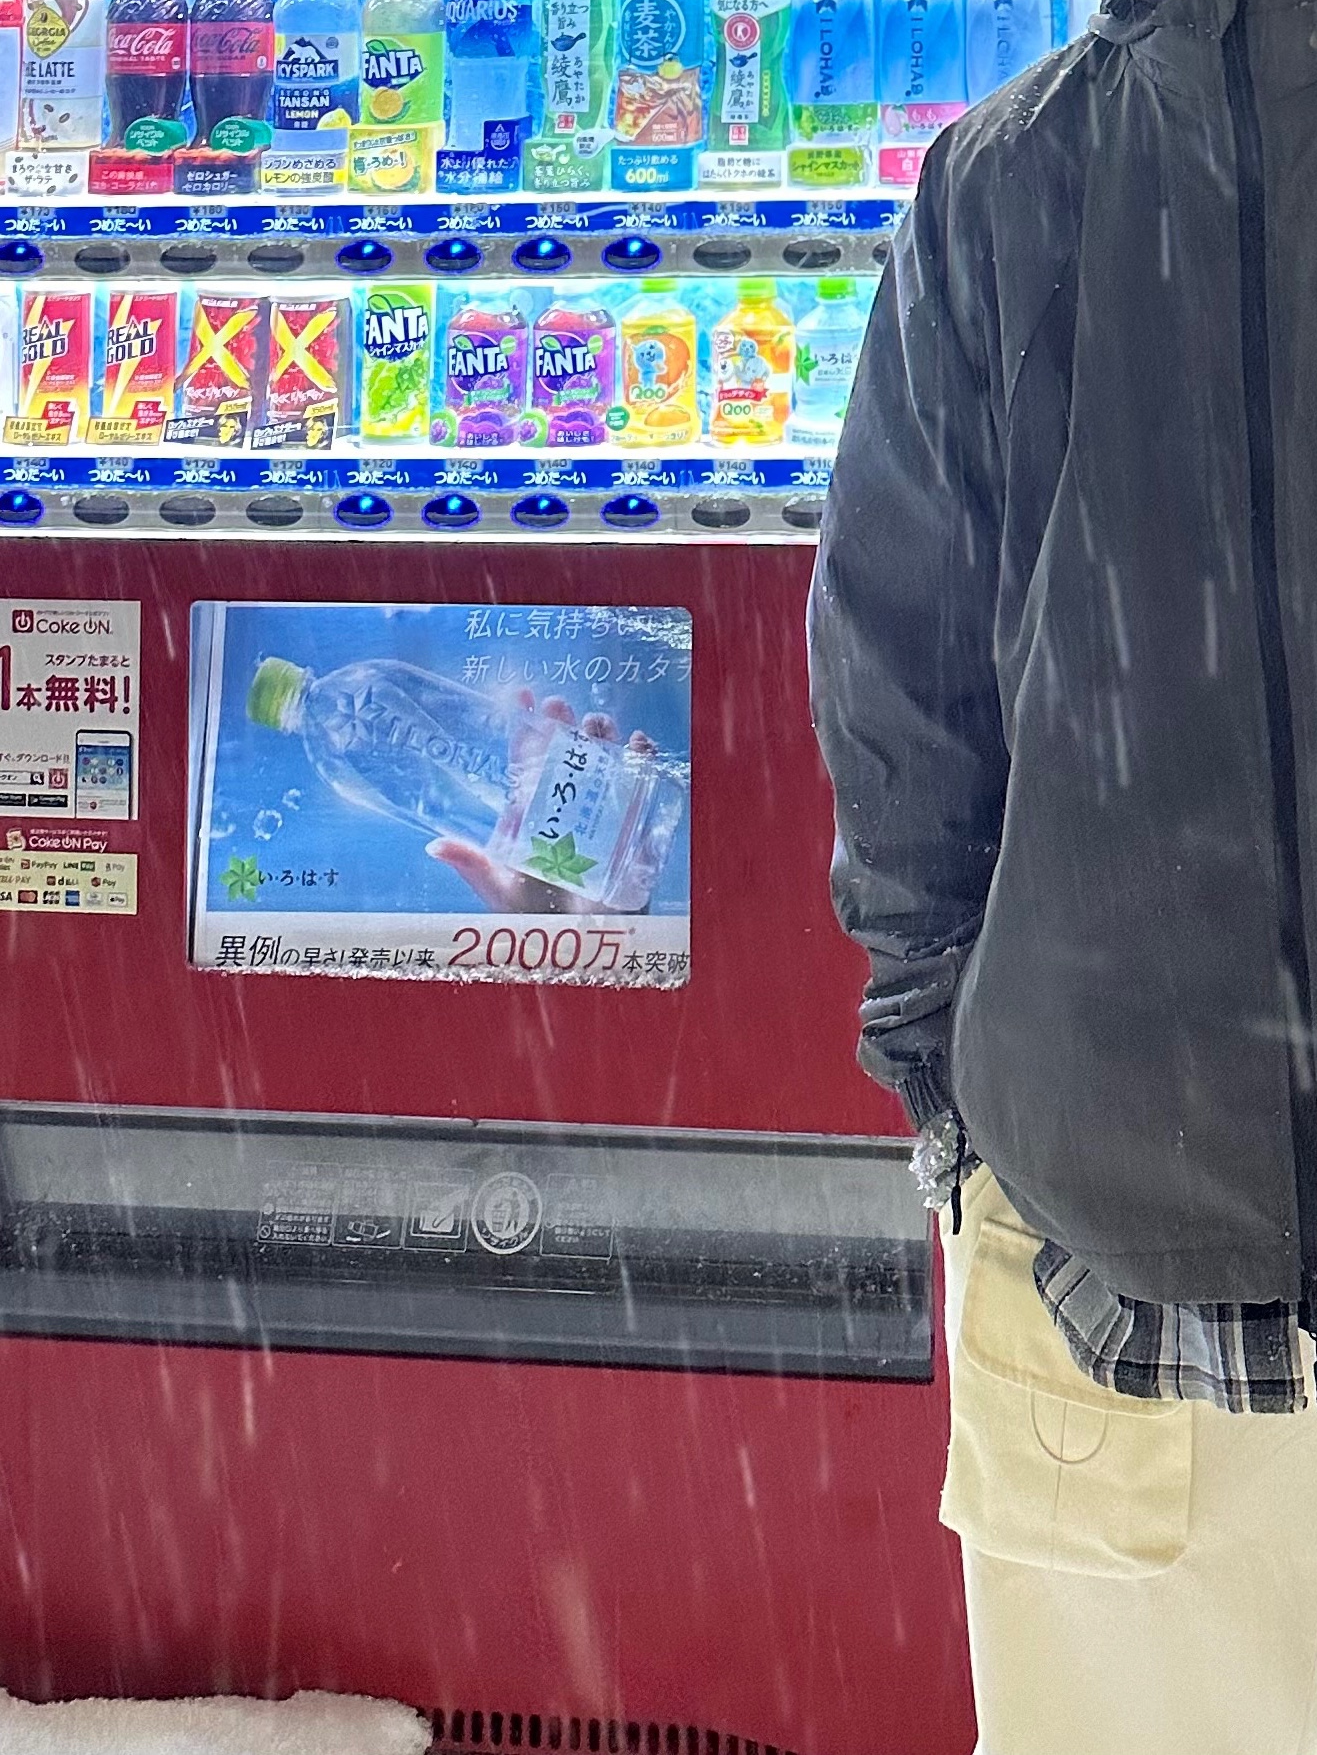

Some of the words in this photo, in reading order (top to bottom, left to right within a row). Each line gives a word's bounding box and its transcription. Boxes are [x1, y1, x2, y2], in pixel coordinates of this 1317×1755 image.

[551, 2, 589, 17] 香り立つ
[717, 0, 769, 13] 気になる方へ
[557, 17, 576, 31] 旨み
[632, 0, 664, 57] 麦茶
[38, 61, 76, 78] LATTE
[362, 51, 423, 79] FANTA
[551, 55, 573, 107] 綾鷹
[573, 55, 586, 104] あやたか
[279, 96, 330, 108] TANSAN
[285, 110, 319, 119] LEMON
[617, 153, 679, 166] たっぷり飲める
[186, 169, 238, 181] ゼロシュガー
[264, 171, 335, 185] レモンの強炭酸
[625, 167, 669, 184] 600ml
[22, 319, 67, 344] REAL
[108, 319, 155, 344] REAL
[365, 308, 429, 347] FANTA
[21, 337, 69, 365] GOLD
[106, 337, 155, 365] GOLD
[448, 346, 509, 377] FANTA
[535, 345, 597, 377] FANTA
[630, 384, 667, 401] Qoo
[722, 402, 752, 418] Qoo
[36, 619, 81, 634] Coke
[45, 654, 131, 668] スタンプたまると
[28, 835, 61, 849] Coke
[82, 837, 109, 853] Pay
